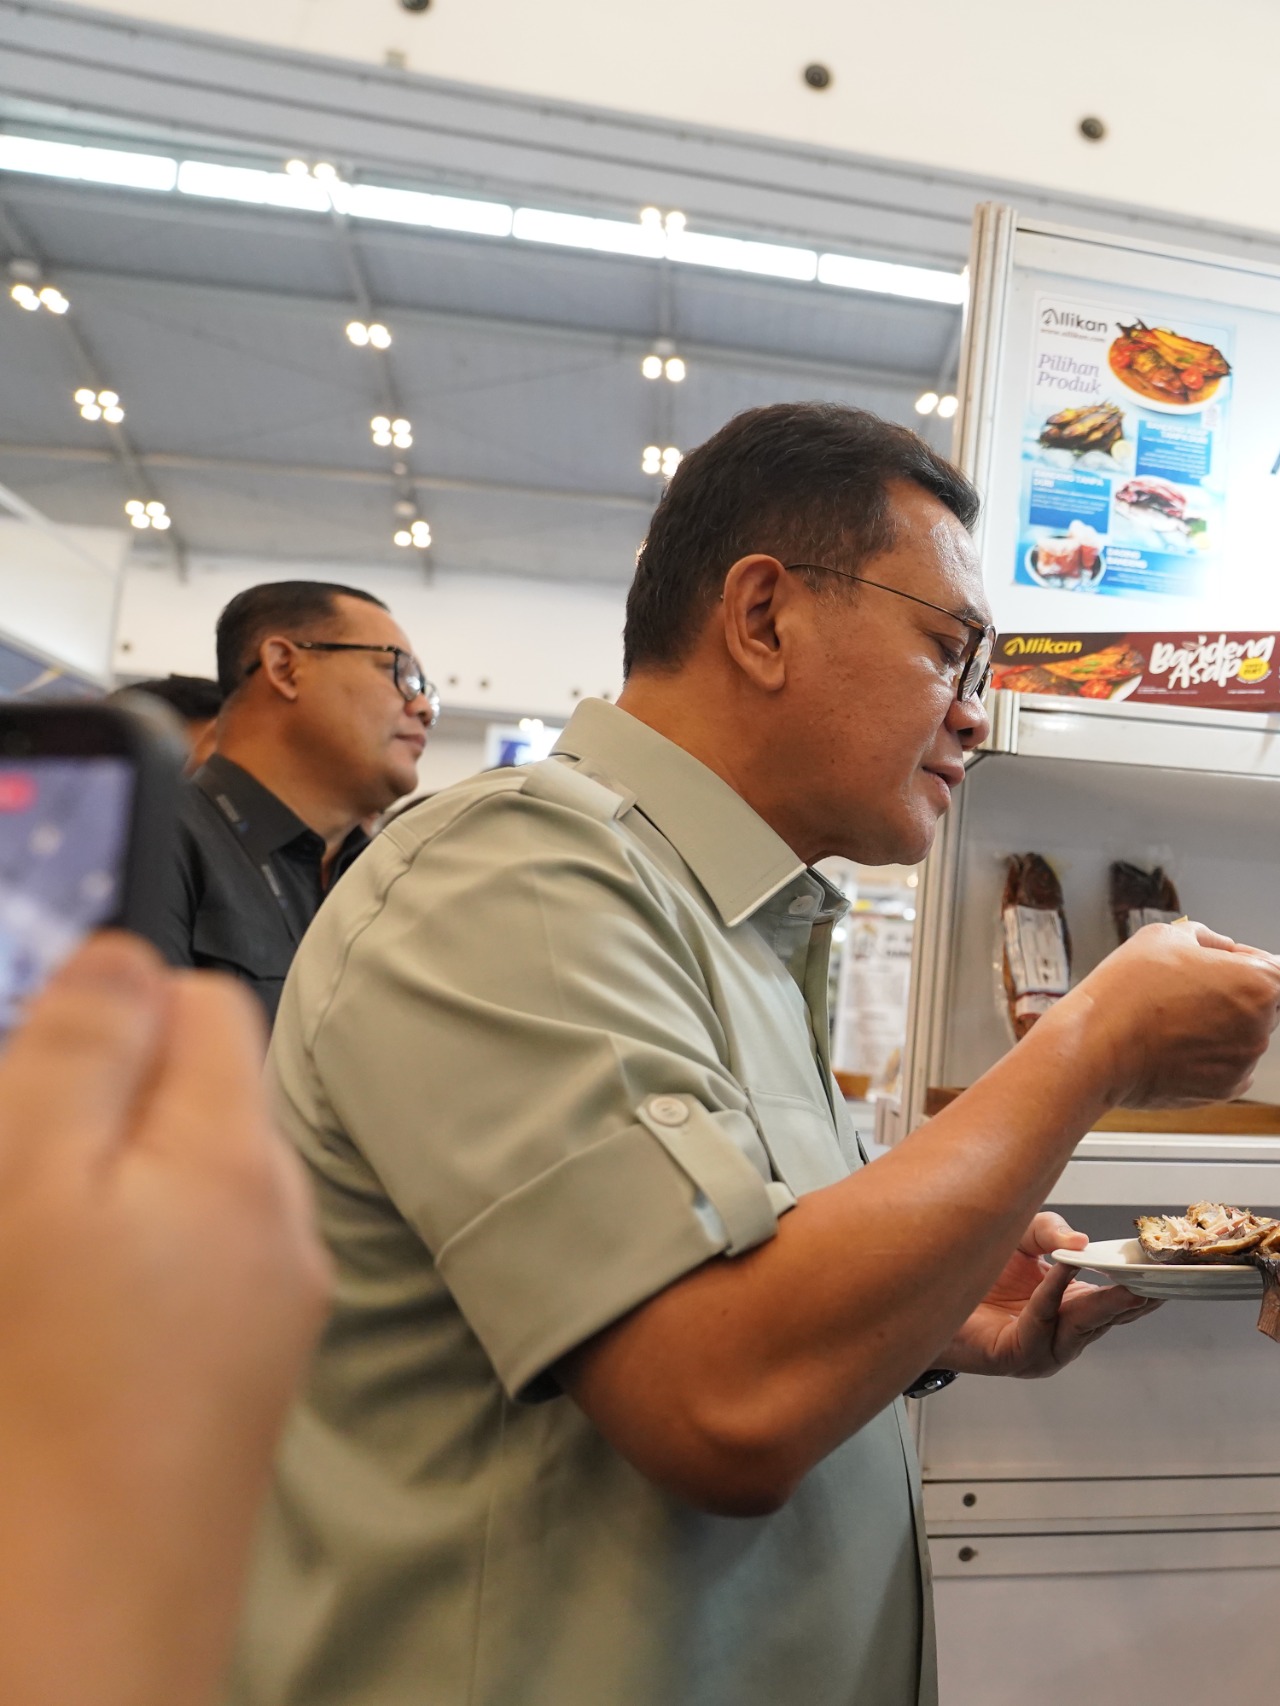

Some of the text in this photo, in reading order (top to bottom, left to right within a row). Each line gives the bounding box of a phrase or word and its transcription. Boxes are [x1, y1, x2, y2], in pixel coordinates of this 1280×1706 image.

[1042, 309, 1107, 333] Allikan
[1038, 354, 1099, 377] Pilihan
[1036, 371, 1101, 394] Produk
[1003, 636, 1082, 656] Allikan
[1149, 633, 1276, 674] Bandeng
[1168, 657, 1242, 689] Asap
